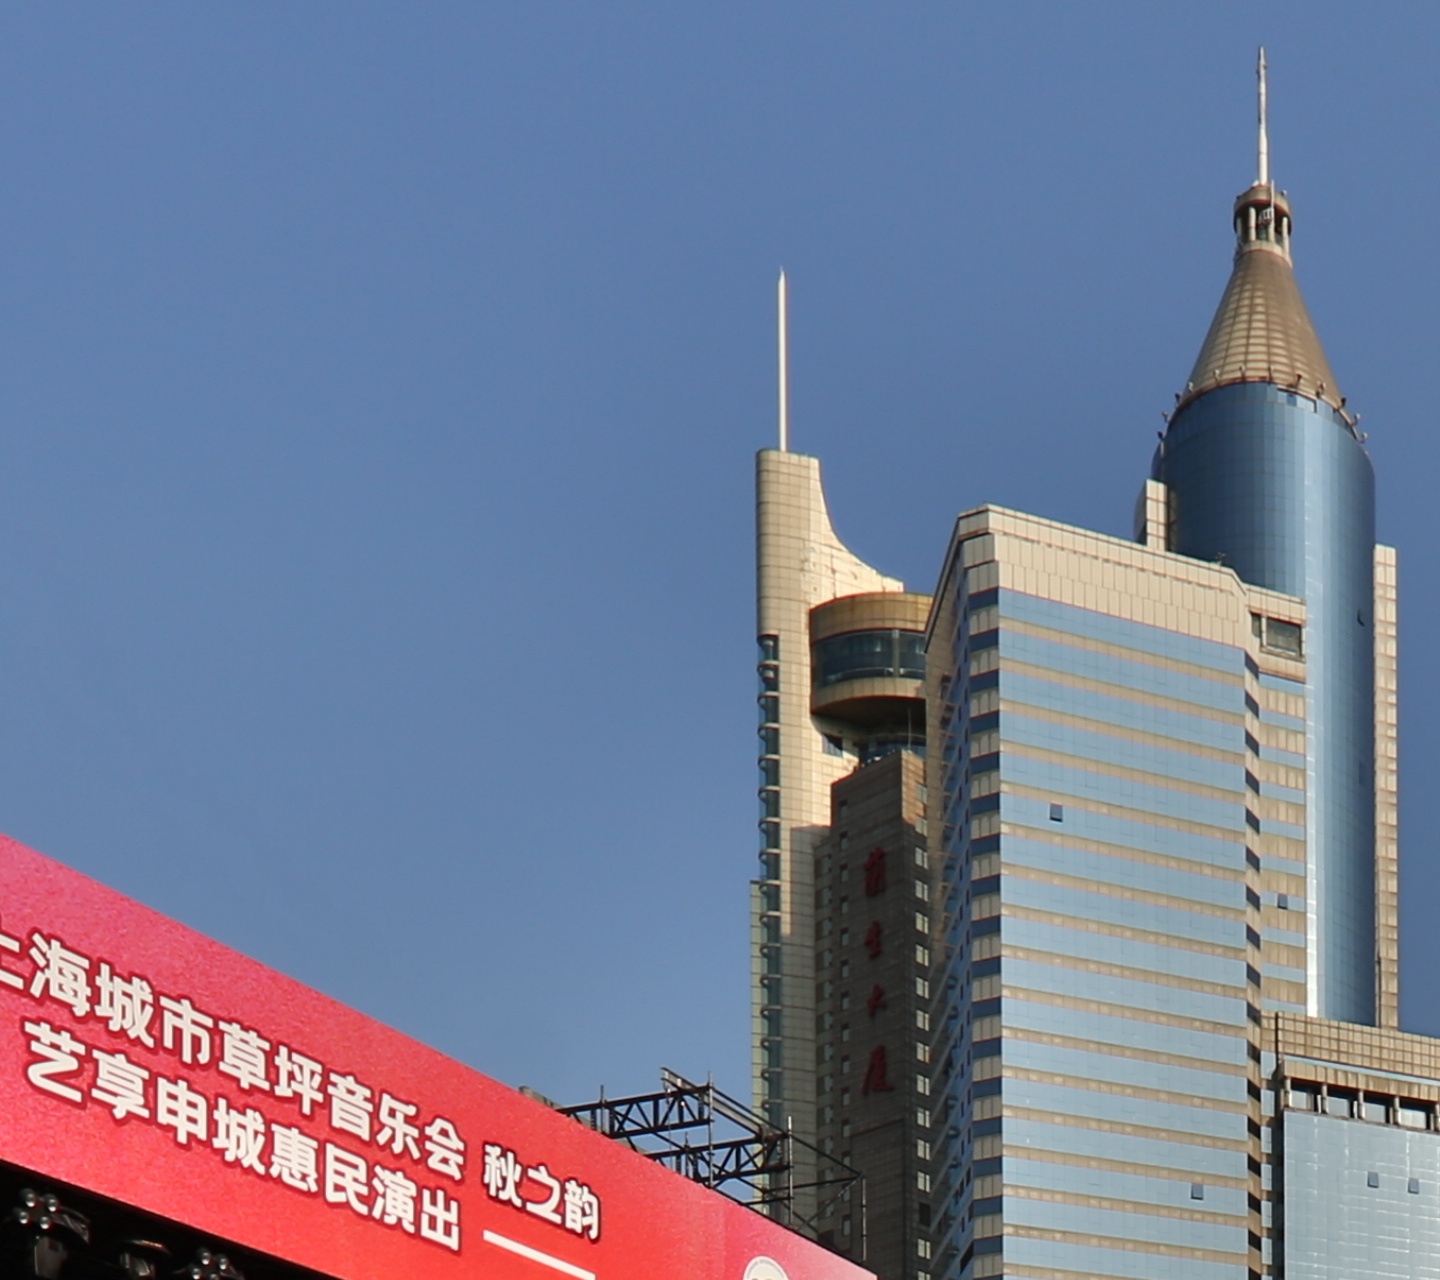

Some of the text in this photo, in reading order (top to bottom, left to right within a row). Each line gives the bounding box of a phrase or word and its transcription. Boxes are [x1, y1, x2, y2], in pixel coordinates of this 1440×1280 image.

[23, 1020, 463, 1252] 艺享申城惠民演出
[482, 1142, 602, 1242] 秋之韵
